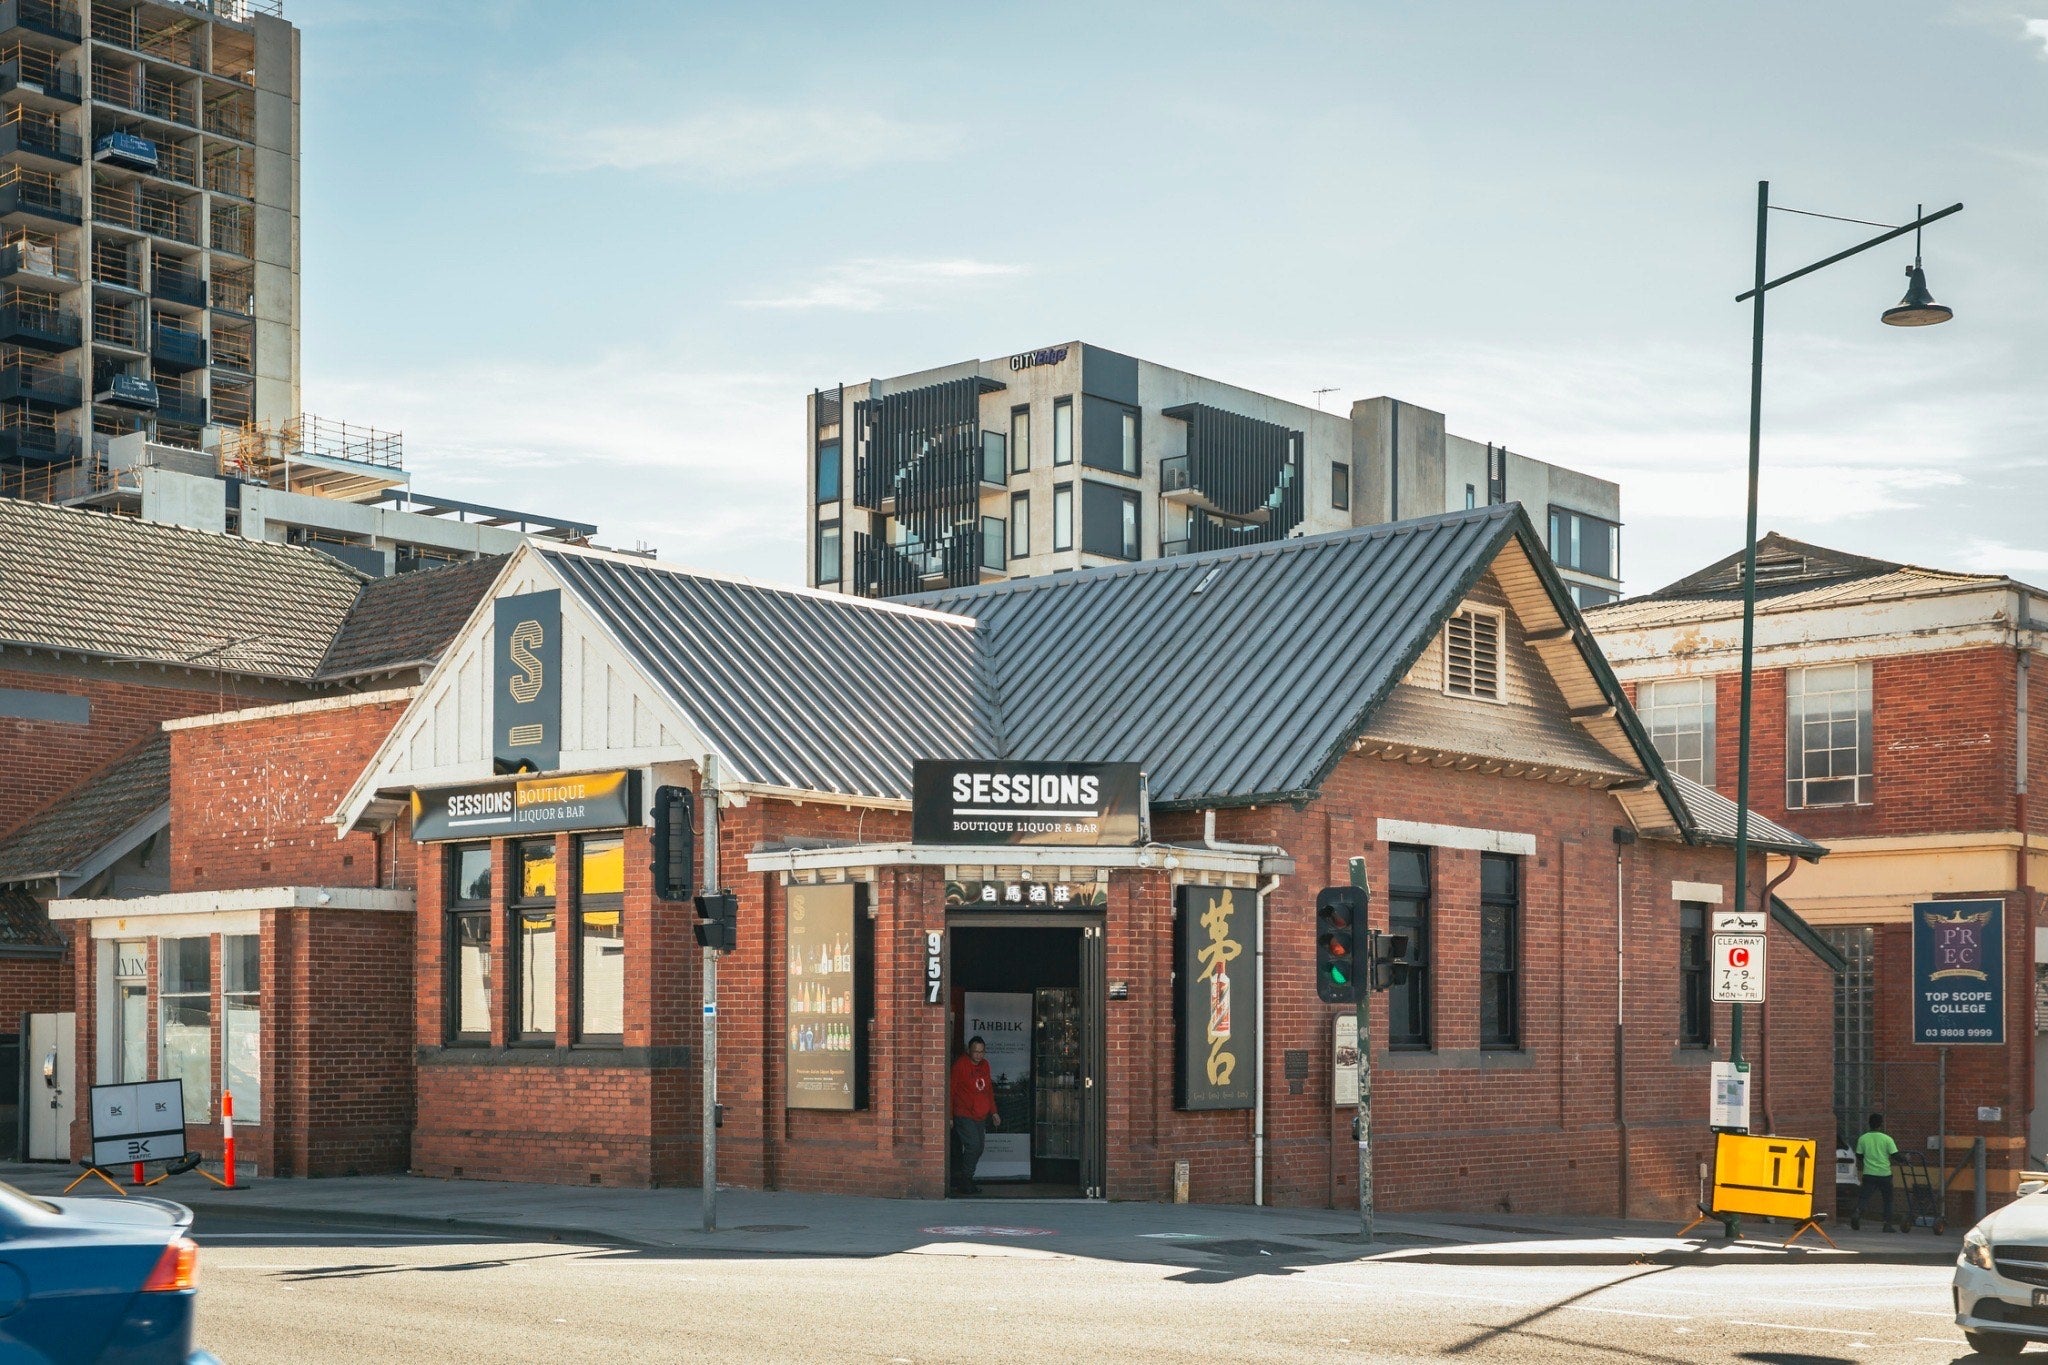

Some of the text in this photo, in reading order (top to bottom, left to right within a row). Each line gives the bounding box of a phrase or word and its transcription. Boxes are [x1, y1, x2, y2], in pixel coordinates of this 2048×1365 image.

[953, 773, 1100, 805] SESSIONS
[448, 784, 586, 817] SESSIONS BOUTIQUE
[518, 805, 585, 823] LIQUOR & BAR
[953, 821, 1098, 833] BOUTIQUE LIQUOR & BAR
[1717, 938, 1761, 946] CLEARWAY
[928, 932, 941, 1003] 957
[1925, 992, 1992, 1001] TOP SCOPE
[1931, 1004, 1986, 1013] COLLEGE
[1925, 1028, 1993, 1037] 03 9808 9999
